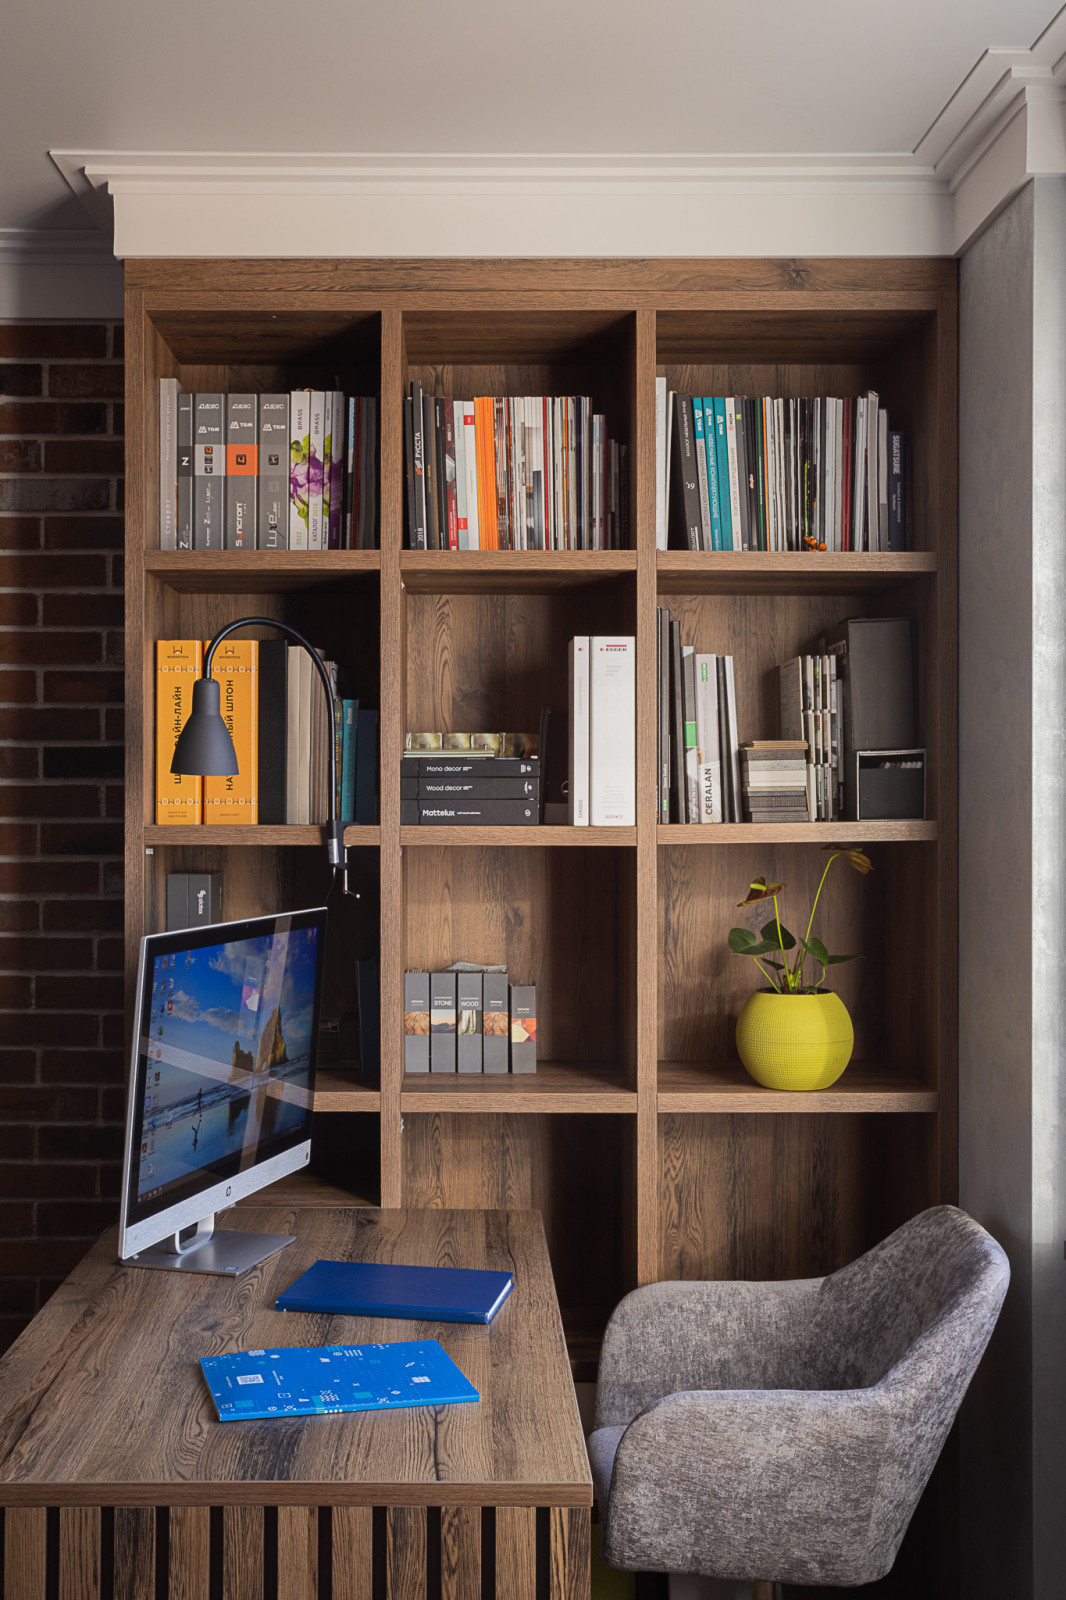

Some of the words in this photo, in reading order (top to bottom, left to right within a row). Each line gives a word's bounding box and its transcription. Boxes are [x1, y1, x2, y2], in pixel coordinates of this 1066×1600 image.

[892, 435, 900, 475] SUGATSUNE
[235, 503, 243, 547] Syncron
[226, 680, 234, 712] ШПОН
[704, 768, 713, 815] CERALAN
[422, 809, 456, 817] Mattelux
